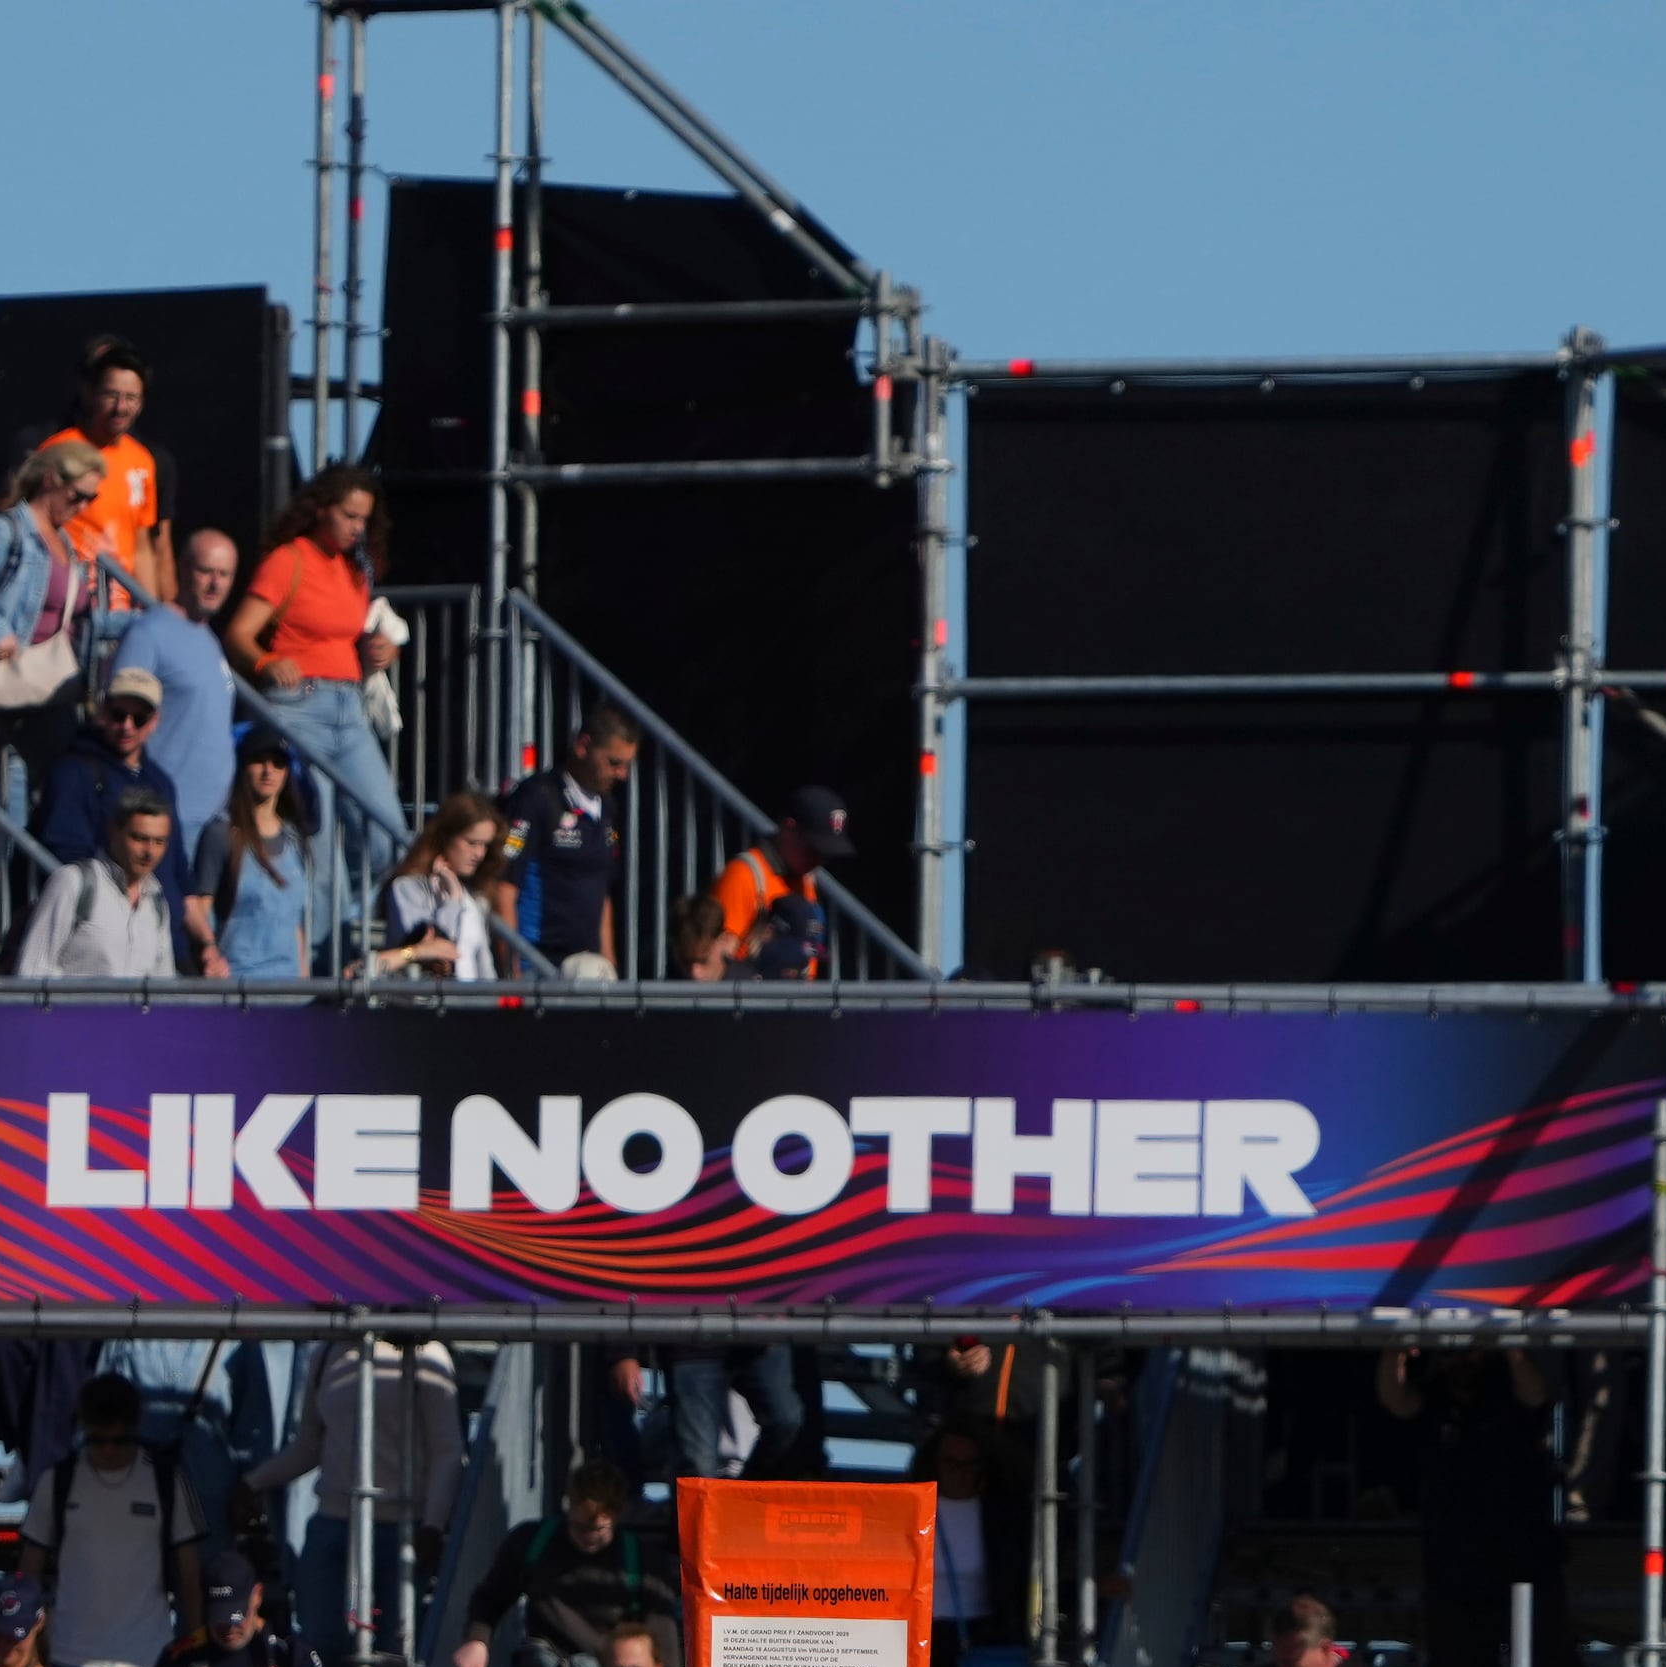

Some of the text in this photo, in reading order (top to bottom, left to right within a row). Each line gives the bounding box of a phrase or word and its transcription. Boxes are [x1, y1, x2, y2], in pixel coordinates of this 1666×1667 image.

[45, 1093, 1321, 1217] LIKE NO OTHER
[724, 1582, 889, 1606] Halte tijdelijk opgeheven.
